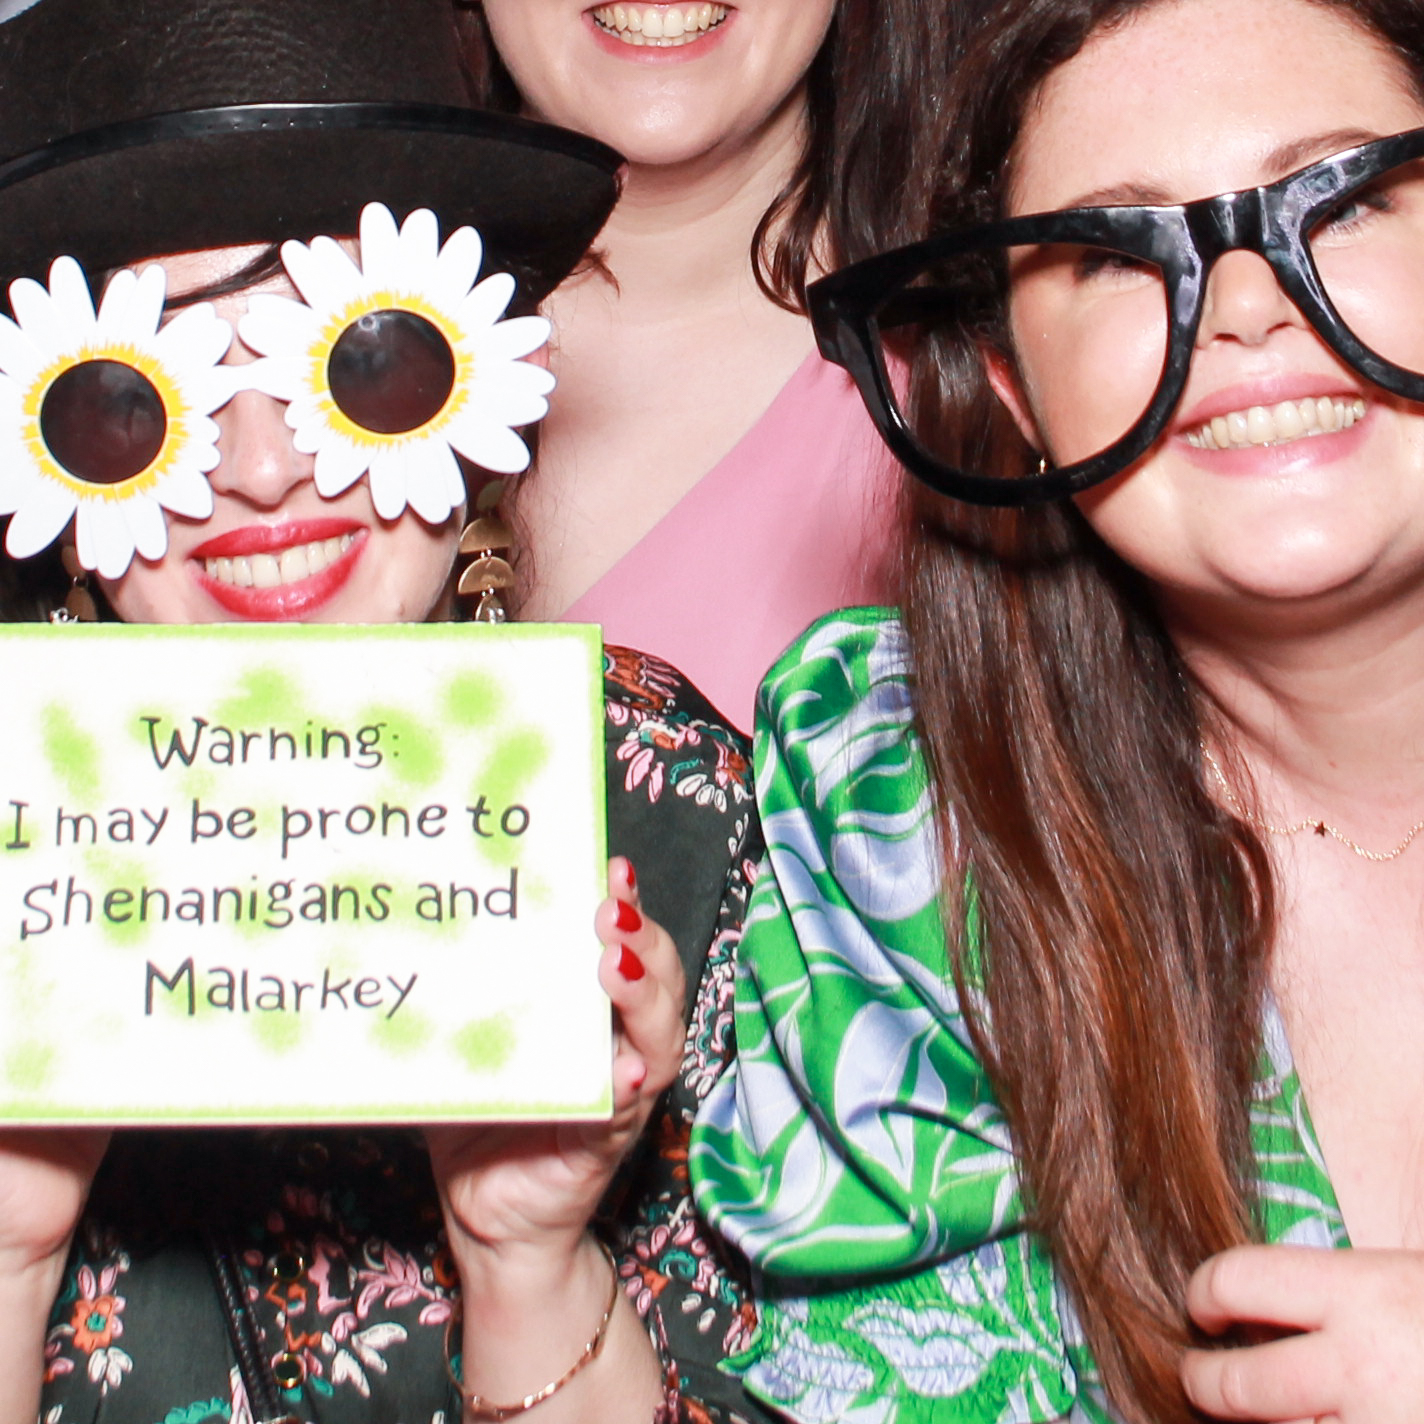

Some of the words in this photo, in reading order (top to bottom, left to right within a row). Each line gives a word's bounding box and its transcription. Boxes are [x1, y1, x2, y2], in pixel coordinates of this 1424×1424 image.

[141, 717, 398, 770] Warning:
[6, 800, 30, 850] I
[56, 807, 169, 846] may
[191, 799, 257, 843] be
[281, 803, 448, 859] prone
[466, 796, 530, 838] to
[20, 876, 392, 941] Shenanigans
[415, 868, 518, 923] and
[145, 957, 418, 1019] Malarkey
